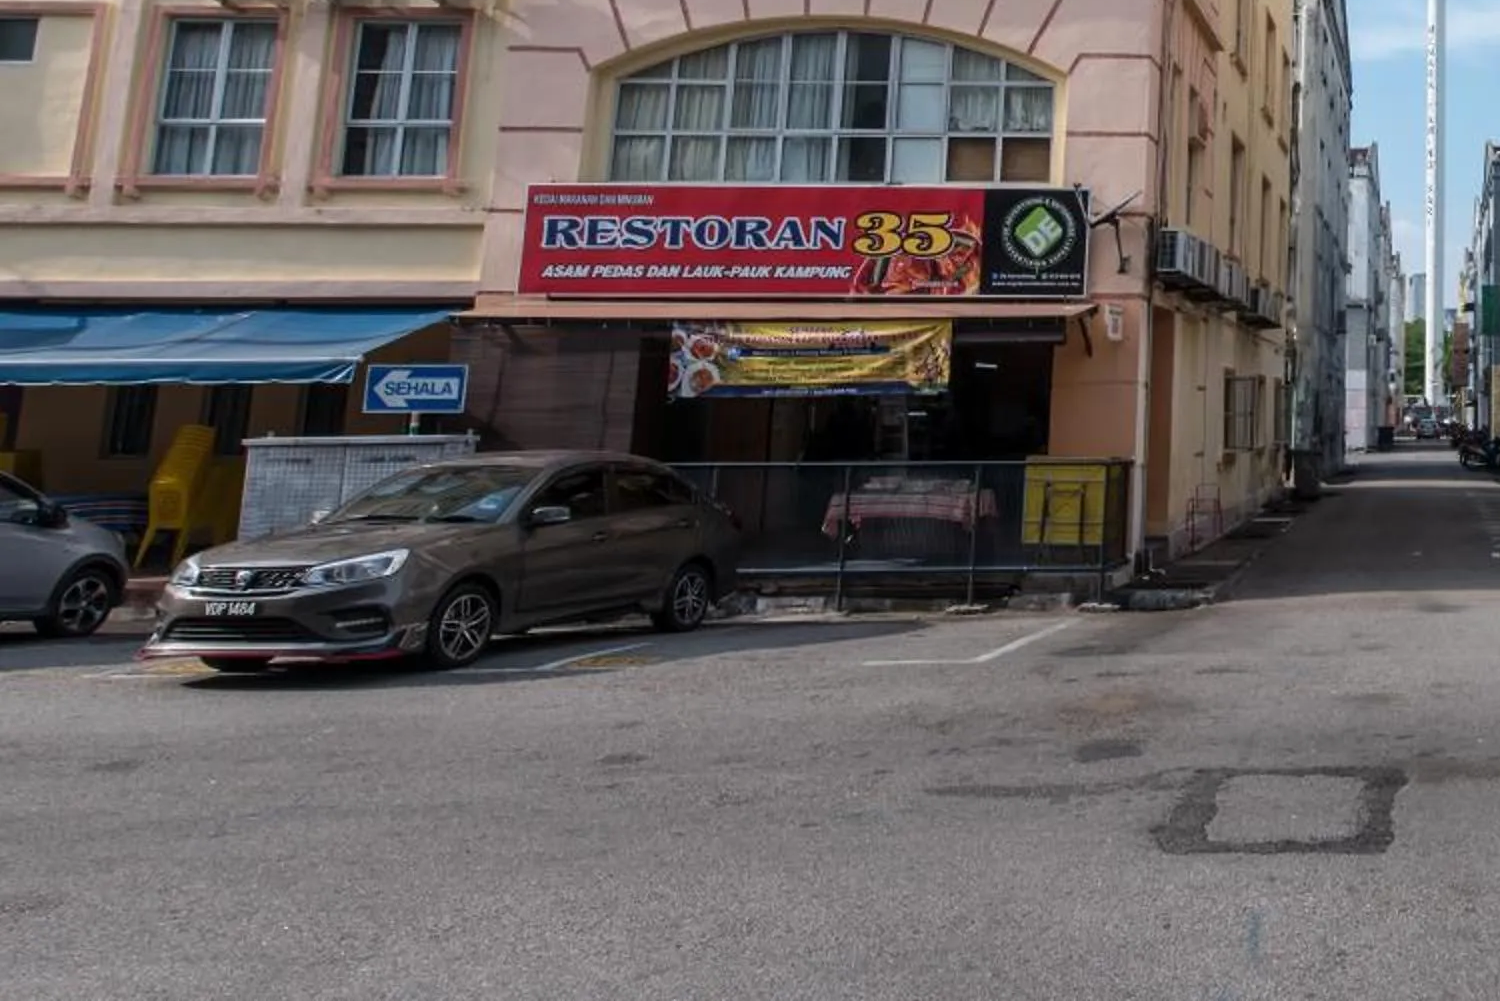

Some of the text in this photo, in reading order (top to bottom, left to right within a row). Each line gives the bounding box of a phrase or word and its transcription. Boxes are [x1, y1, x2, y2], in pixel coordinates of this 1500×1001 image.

[541, 211, 953, 257] RESTORAN 35
[542, 265, 852, 278] ASAM PEDAS DAN LAUK-PAUK KAMPUNG
[384, 381, 453, 396] SEHALA
